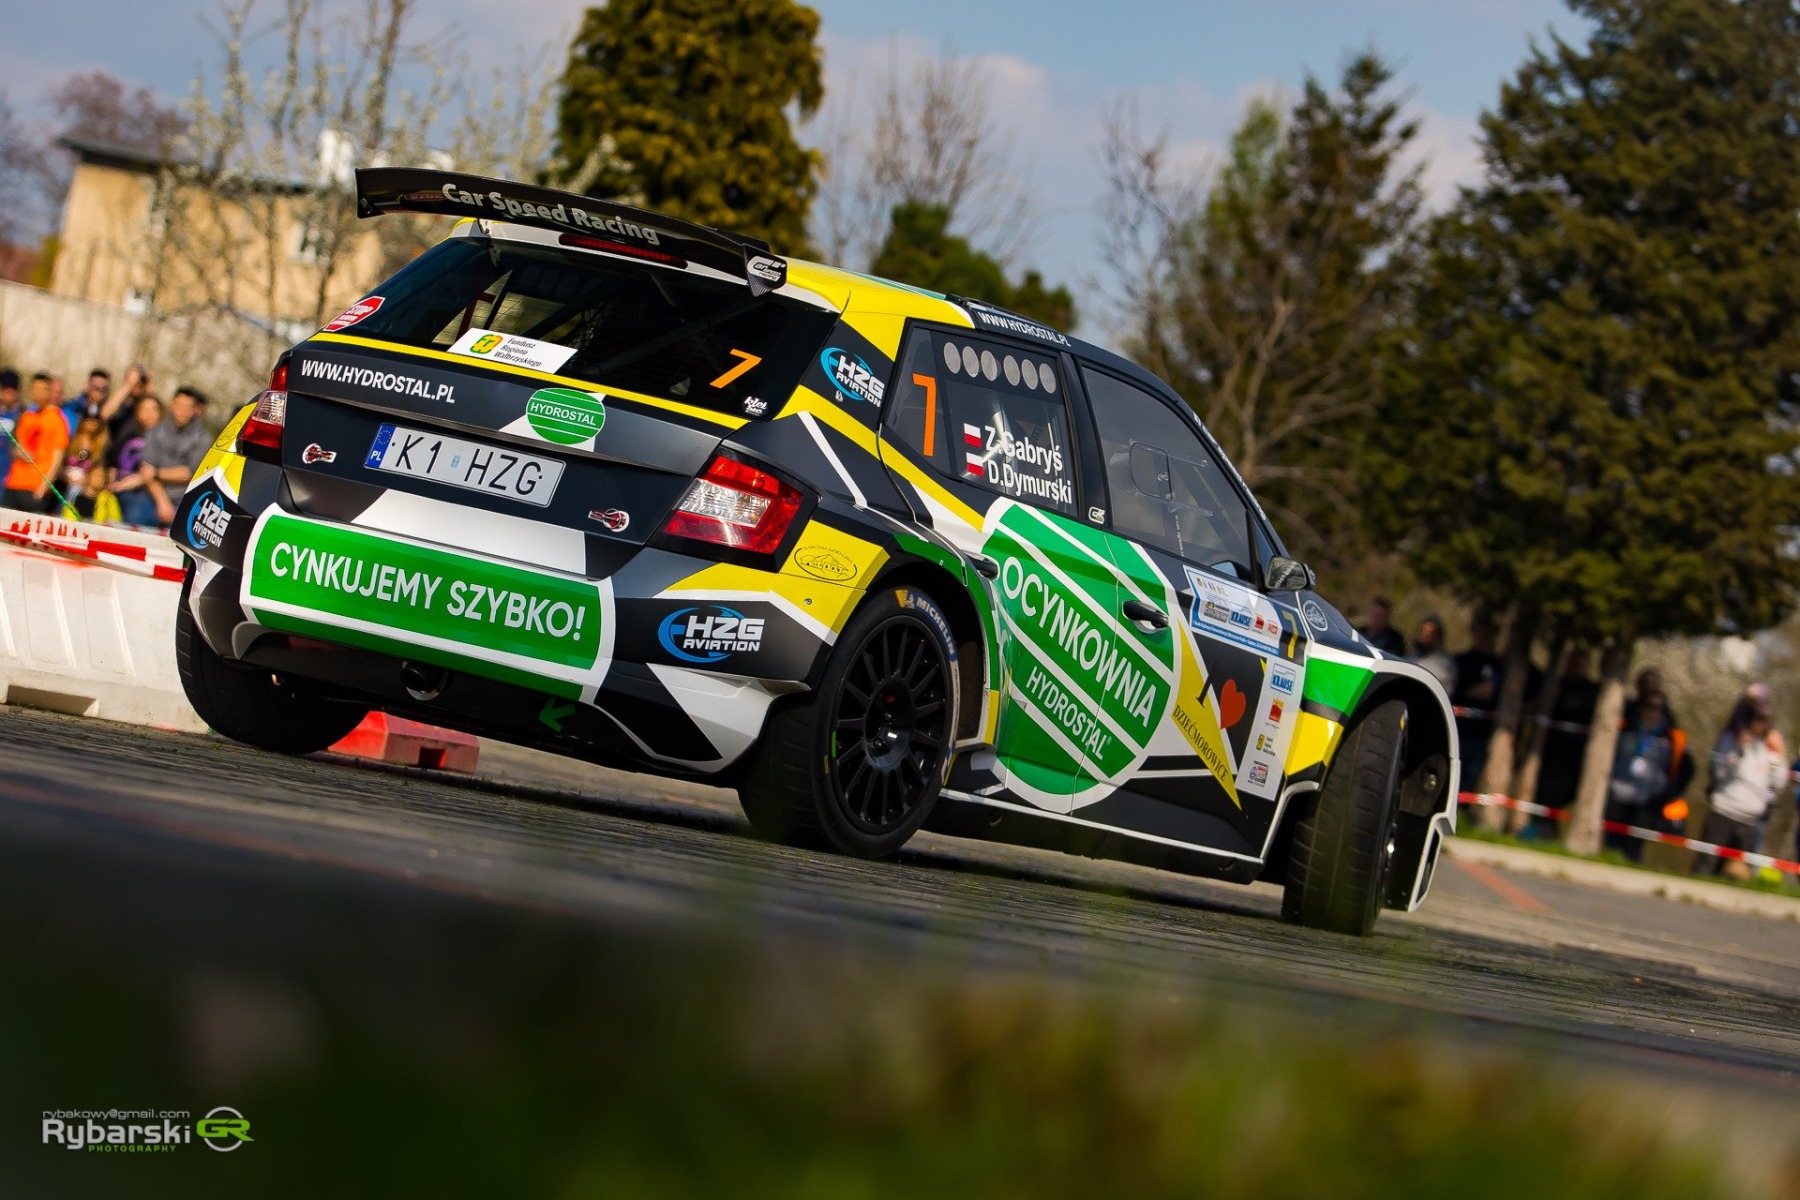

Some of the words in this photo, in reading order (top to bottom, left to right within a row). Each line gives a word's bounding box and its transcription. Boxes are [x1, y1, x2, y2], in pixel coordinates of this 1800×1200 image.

[442, 182, 484, 207] Car
[492, 192, 569, 225] Speed
[571, 207, 661, 246] Racing
[500, 344, 529, 356] Regionu
[507, 337, 536, 349] Fundusz
[301, 359, 456, 404] WWW.HYDROSTAL.PL
[709, 348, 763, 389] 7
[835, 369, 883, 408] AVIATION
[837, 354, 885, 396] HZG
[530, 402, 597, 426] HYDROSTAL
[912, 372, 937, 457] 7
[369, 450, 382, 461] PL
[395, 434, 443, 475] K1
[464, 448, 542, 496] HZG
[984, 424, 1063, 472] Z.Gabryś
[988, 458, 1073, 505] D.Dymurski
[193, 520, 223, 548] AVIATION
[199, 497, 233, 535] HZG
[269, 541, 444, 610] CYNKUJEMY
[446, 579, 587, 641] SZYBKO!
[682, 637, 761, 653] AVIATION
[684, 614, 766, 641] HZG
[916, 596, 955, 655] MICHELIN
[1001, 556, 1158, 729] OCYNKOWNIA
[1272, 674, 1294, 692] KRAUSE
[1172, 703, 1229, 782] DZIEĆMOROWICE
